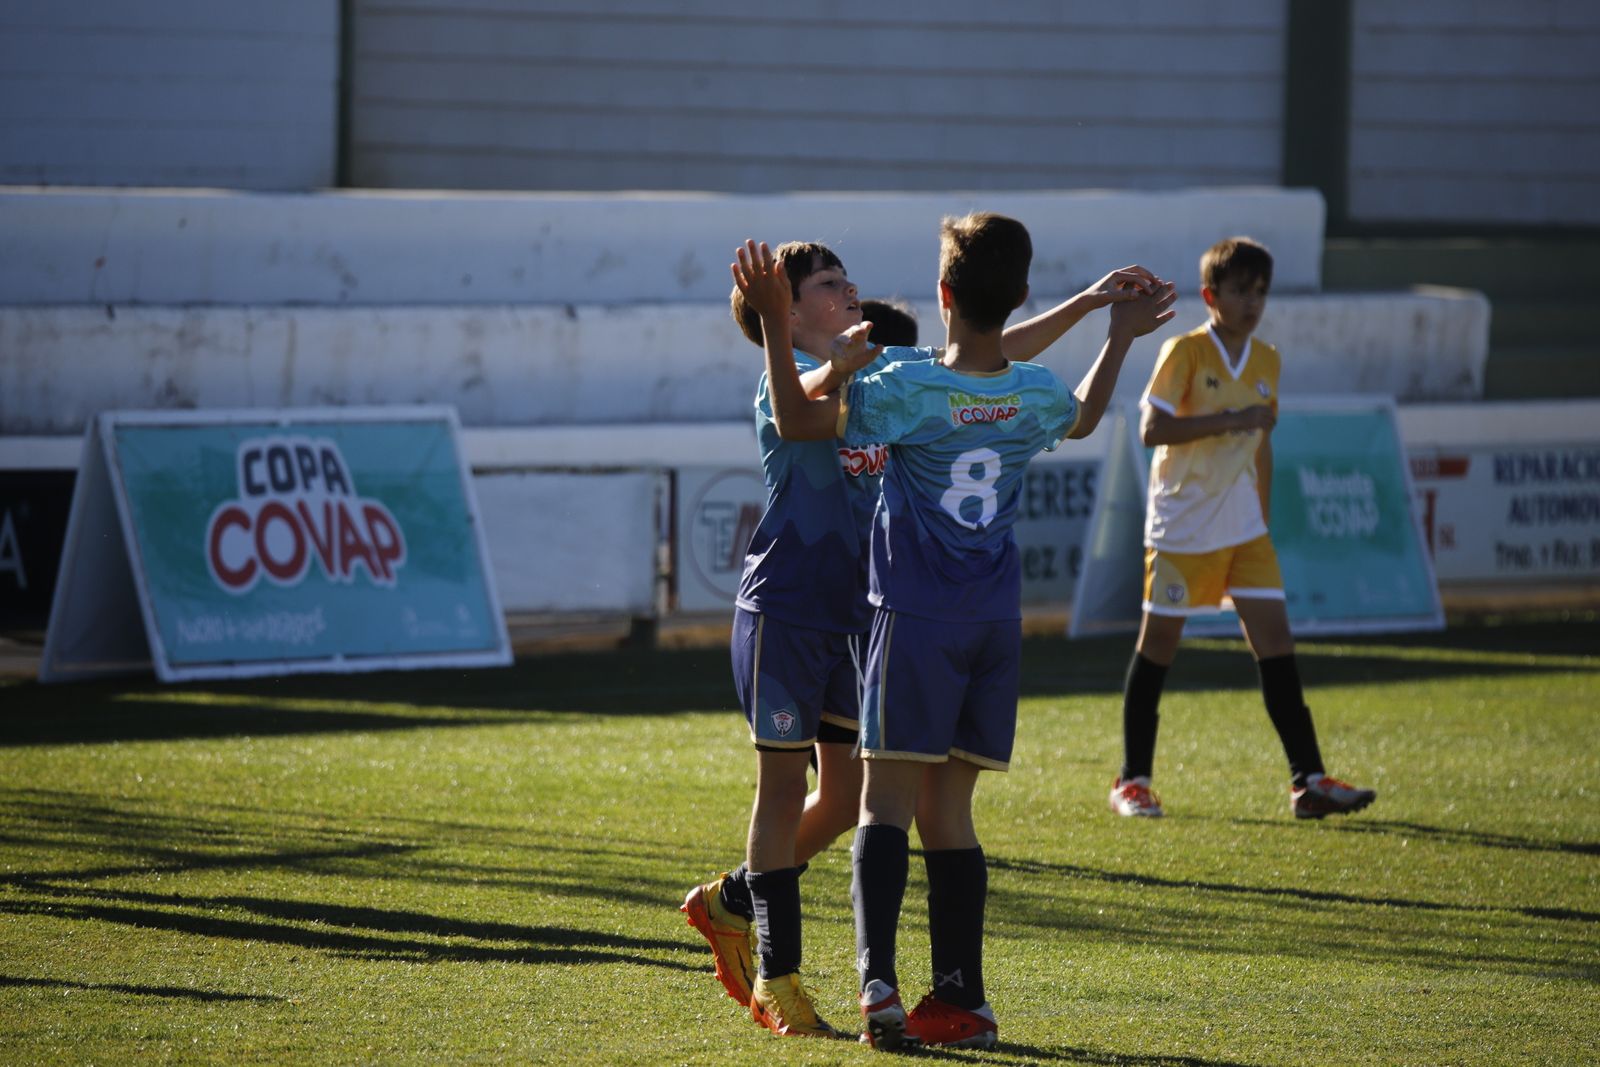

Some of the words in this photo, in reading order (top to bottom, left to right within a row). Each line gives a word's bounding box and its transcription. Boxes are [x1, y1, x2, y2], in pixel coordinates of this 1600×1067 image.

[959, 406, 1019, 425] COVAP
[243, 442, 350, 498] COPA
[940, 447, 1002, 531] 8
[208, 500, 403, 588] COVAP
